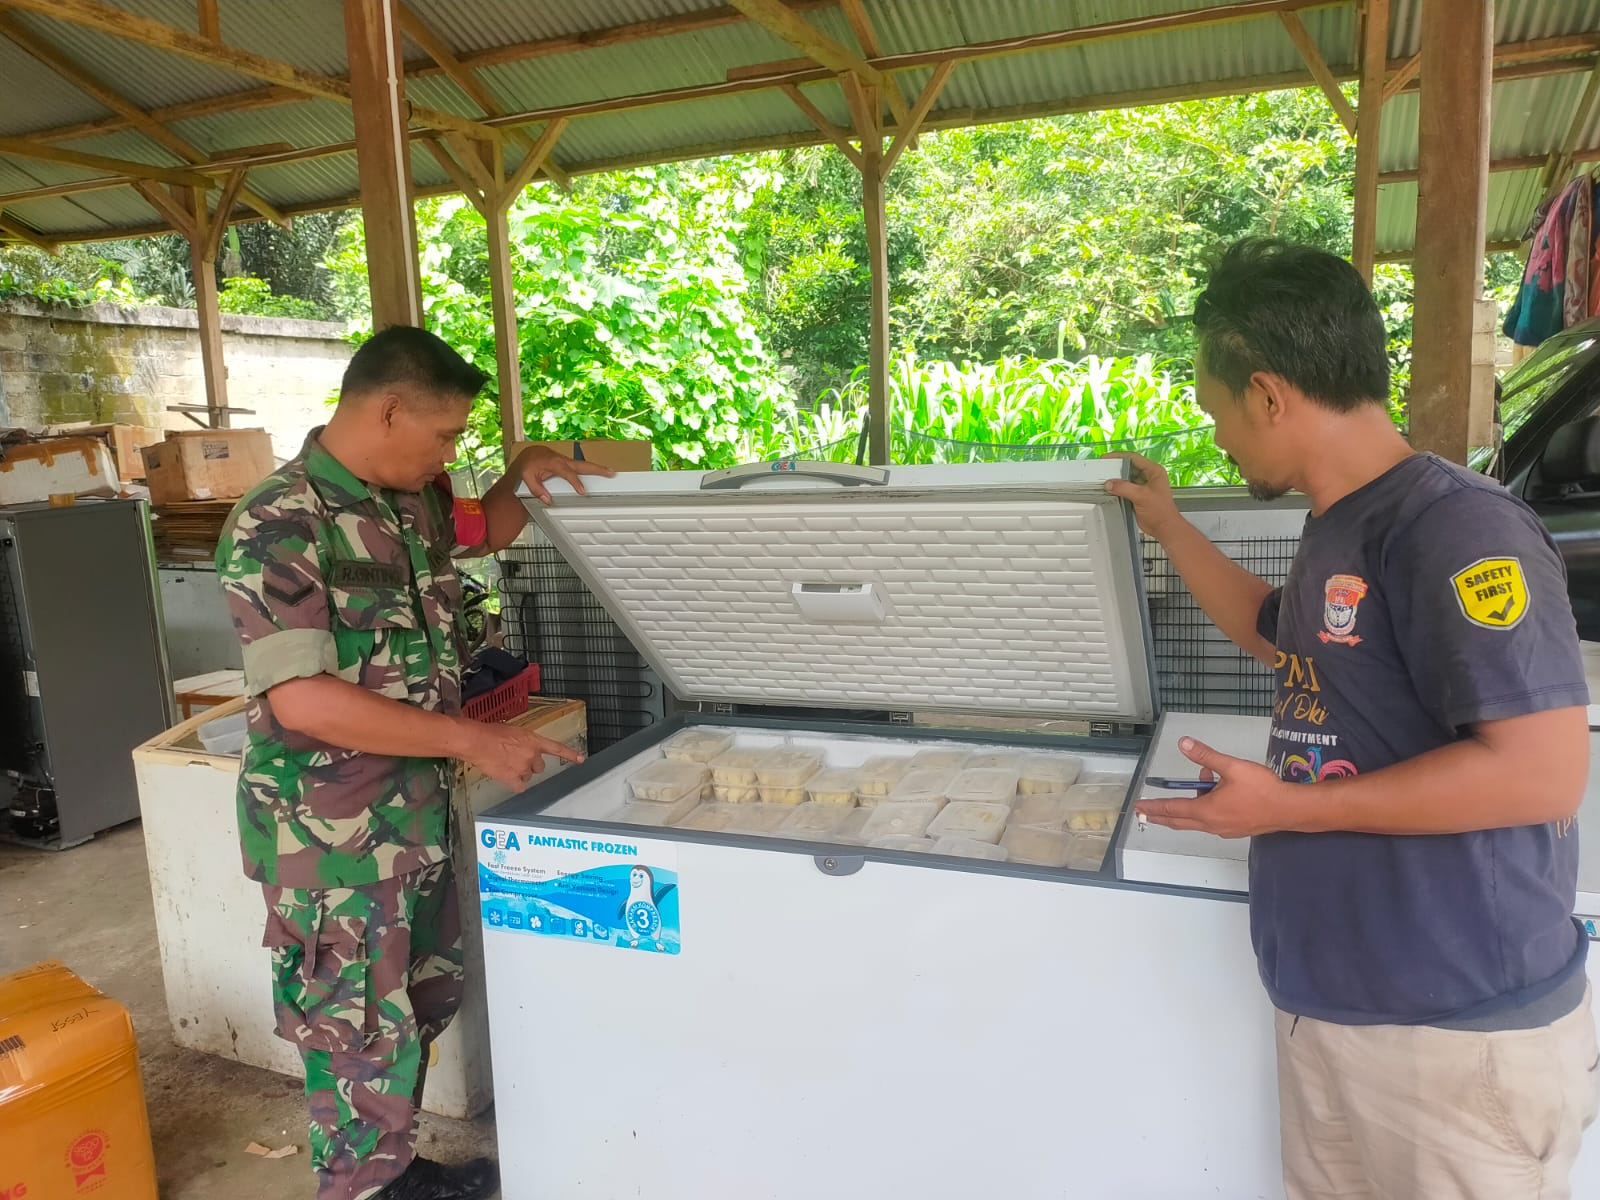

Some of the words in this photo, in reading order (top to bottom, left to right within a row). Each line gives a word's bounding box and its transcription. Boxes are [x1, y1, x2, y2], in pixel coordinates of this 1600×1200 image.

[771, 461, 796, 472] GEA
[1464, 565, 1513, 588] SAFETY
[1475, 581, 1513, 602] FIRST
[481, 829, 520, 852] GEA
[528, 834, 588, 851] FANTASTIC
[591, 842, 638, 857] FROZEN
[522, 866, 546, 875] System
[636, 908, 650, 929] 3
